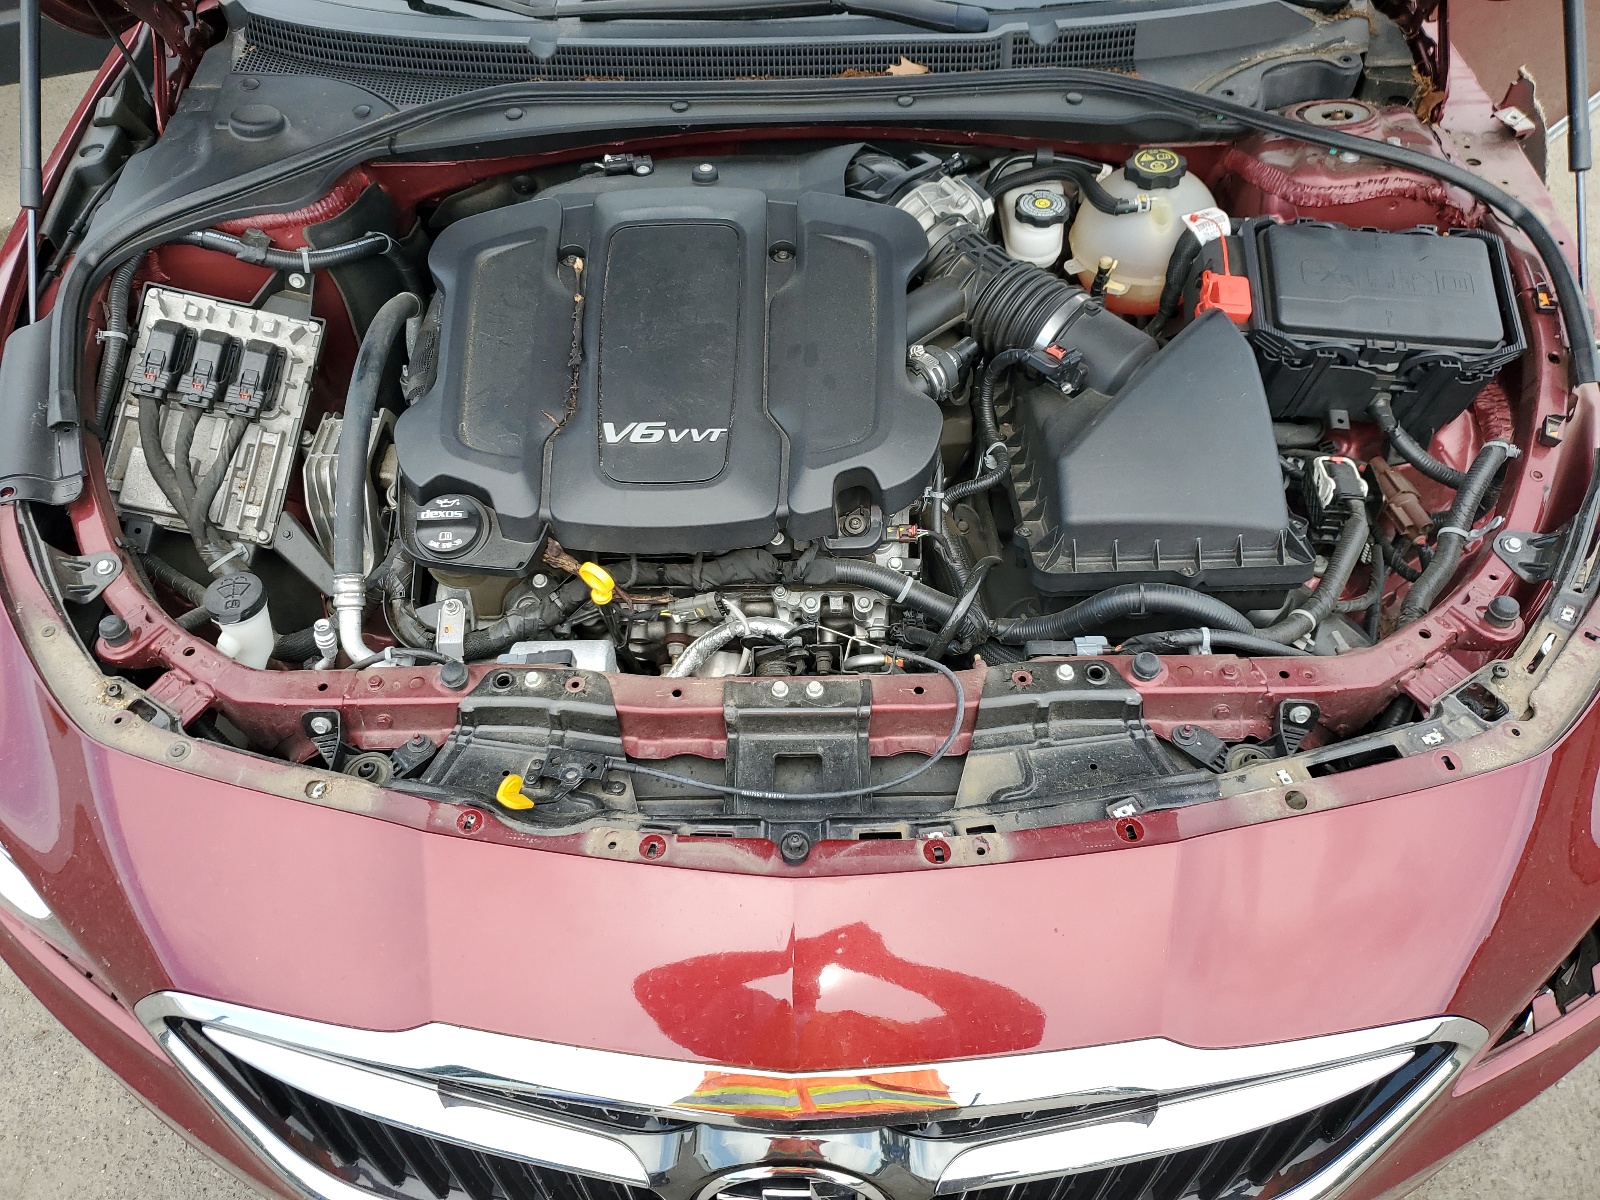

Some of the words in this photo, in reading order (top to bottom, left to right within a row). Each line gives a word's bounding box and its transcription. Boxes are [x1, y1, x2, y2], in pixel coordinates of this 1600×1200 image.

[602, 421, 667, 443] V6
[668, 428, 728, 442] VVT
[420, 509, 465, 519] dexos
